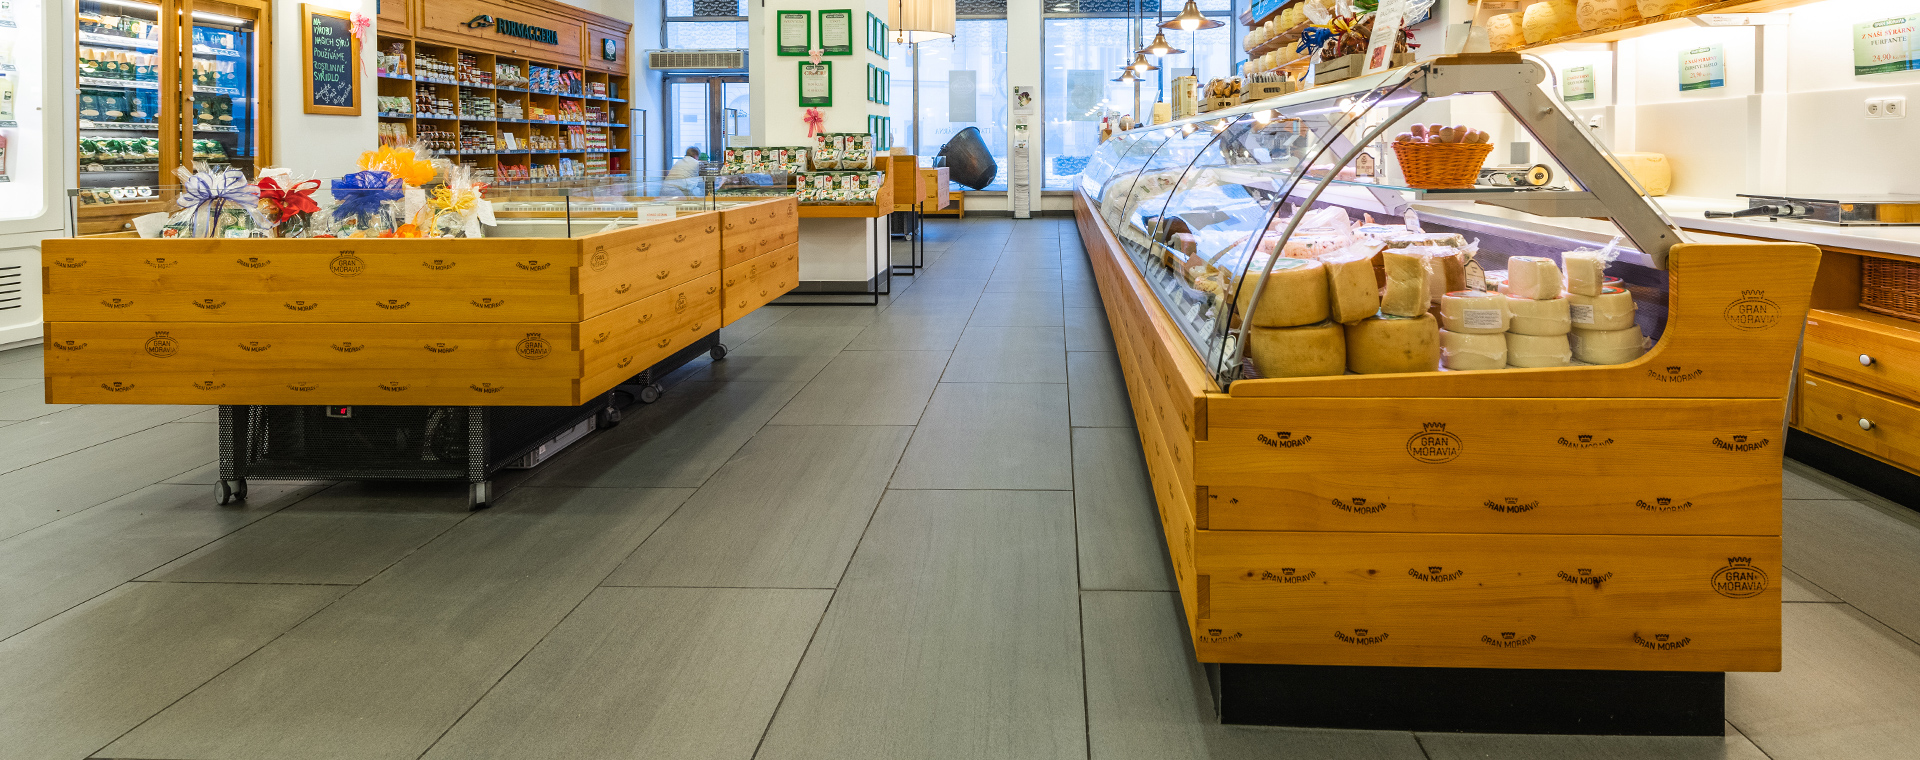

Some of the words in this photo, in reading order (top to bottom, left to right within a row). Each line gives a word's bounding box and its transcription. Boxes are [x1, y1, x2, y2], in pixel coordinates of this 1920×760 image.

[314, 25, 332, 35] VÝROBU
[496, 17, 559, 45] FORMAGGERIA
[1885, 26, 1916, 36] SÝRÁRNY
[314, 36, 334, 46] NAŠICH
[314, 47, 345, 61] POUŽÍVÁME
[1872, 53, 1891, 62] 24,90
[314, 69, 339, 82] SYŘIDLO
[236, 259, 250, 267] GRAN
[516, 262, 529, 271] GRAN
[1739, 304, 1767, 314] GRAN
[1730, 314, 1776, 324] MORAVIA
[53, 342, 66, 350] GRAN
[1647, 369, 1667, 382] GRAN
[1669, 369, 1703, 382] MORAVIA
[1257, 433, 1277, 447] GRAN
[1279, 434, 1312, 448] MORAVIA
[1421, 437, 1448, 447] GRAN
[1557, 437, 1579, 449] GRAN
[1712, 437, 1733, 452] GRAN
[1735, 437, 1770, 452] MORAVIA
[1412, 447, 1457, 456] MORAVIA
[1331, 498, 1352, 513] GRAN
[1353, 502, 1387, 515] MORAVIA
[1483, 499, 1505, 513] GRAN
[1507, 500, 1540, 514] MORAVIA
[1635, 499, 1657, 512] GRAN
[1262, 570, 1282, 583] GRAN
[1284, 570, 1317, 584] MORAVIA
[1408, 568, 1429, 582] GRAN
[1431, 569, 1464, 583] MORAVIA
[1557, 570, 1578, 584] GRAN
[1580, 571, 1613, 585] MORAVIA
[1725, 572, 1754, 581] GRAN
[1717, 582, 1763, 591] MORAVIA
[1199, 634, 1209, 643] AN
[1334, 630, 1355, 644] GRAN
[1356, 632, 1389, 646] MORAVIA
[1480, 634, 1502, 648] GRAN
[1504, 634, 1537, 648] MORAVIA
[1634, 636, 1656, 650] GRAN
[1658, 636, 1691, 650] MORAVIA
